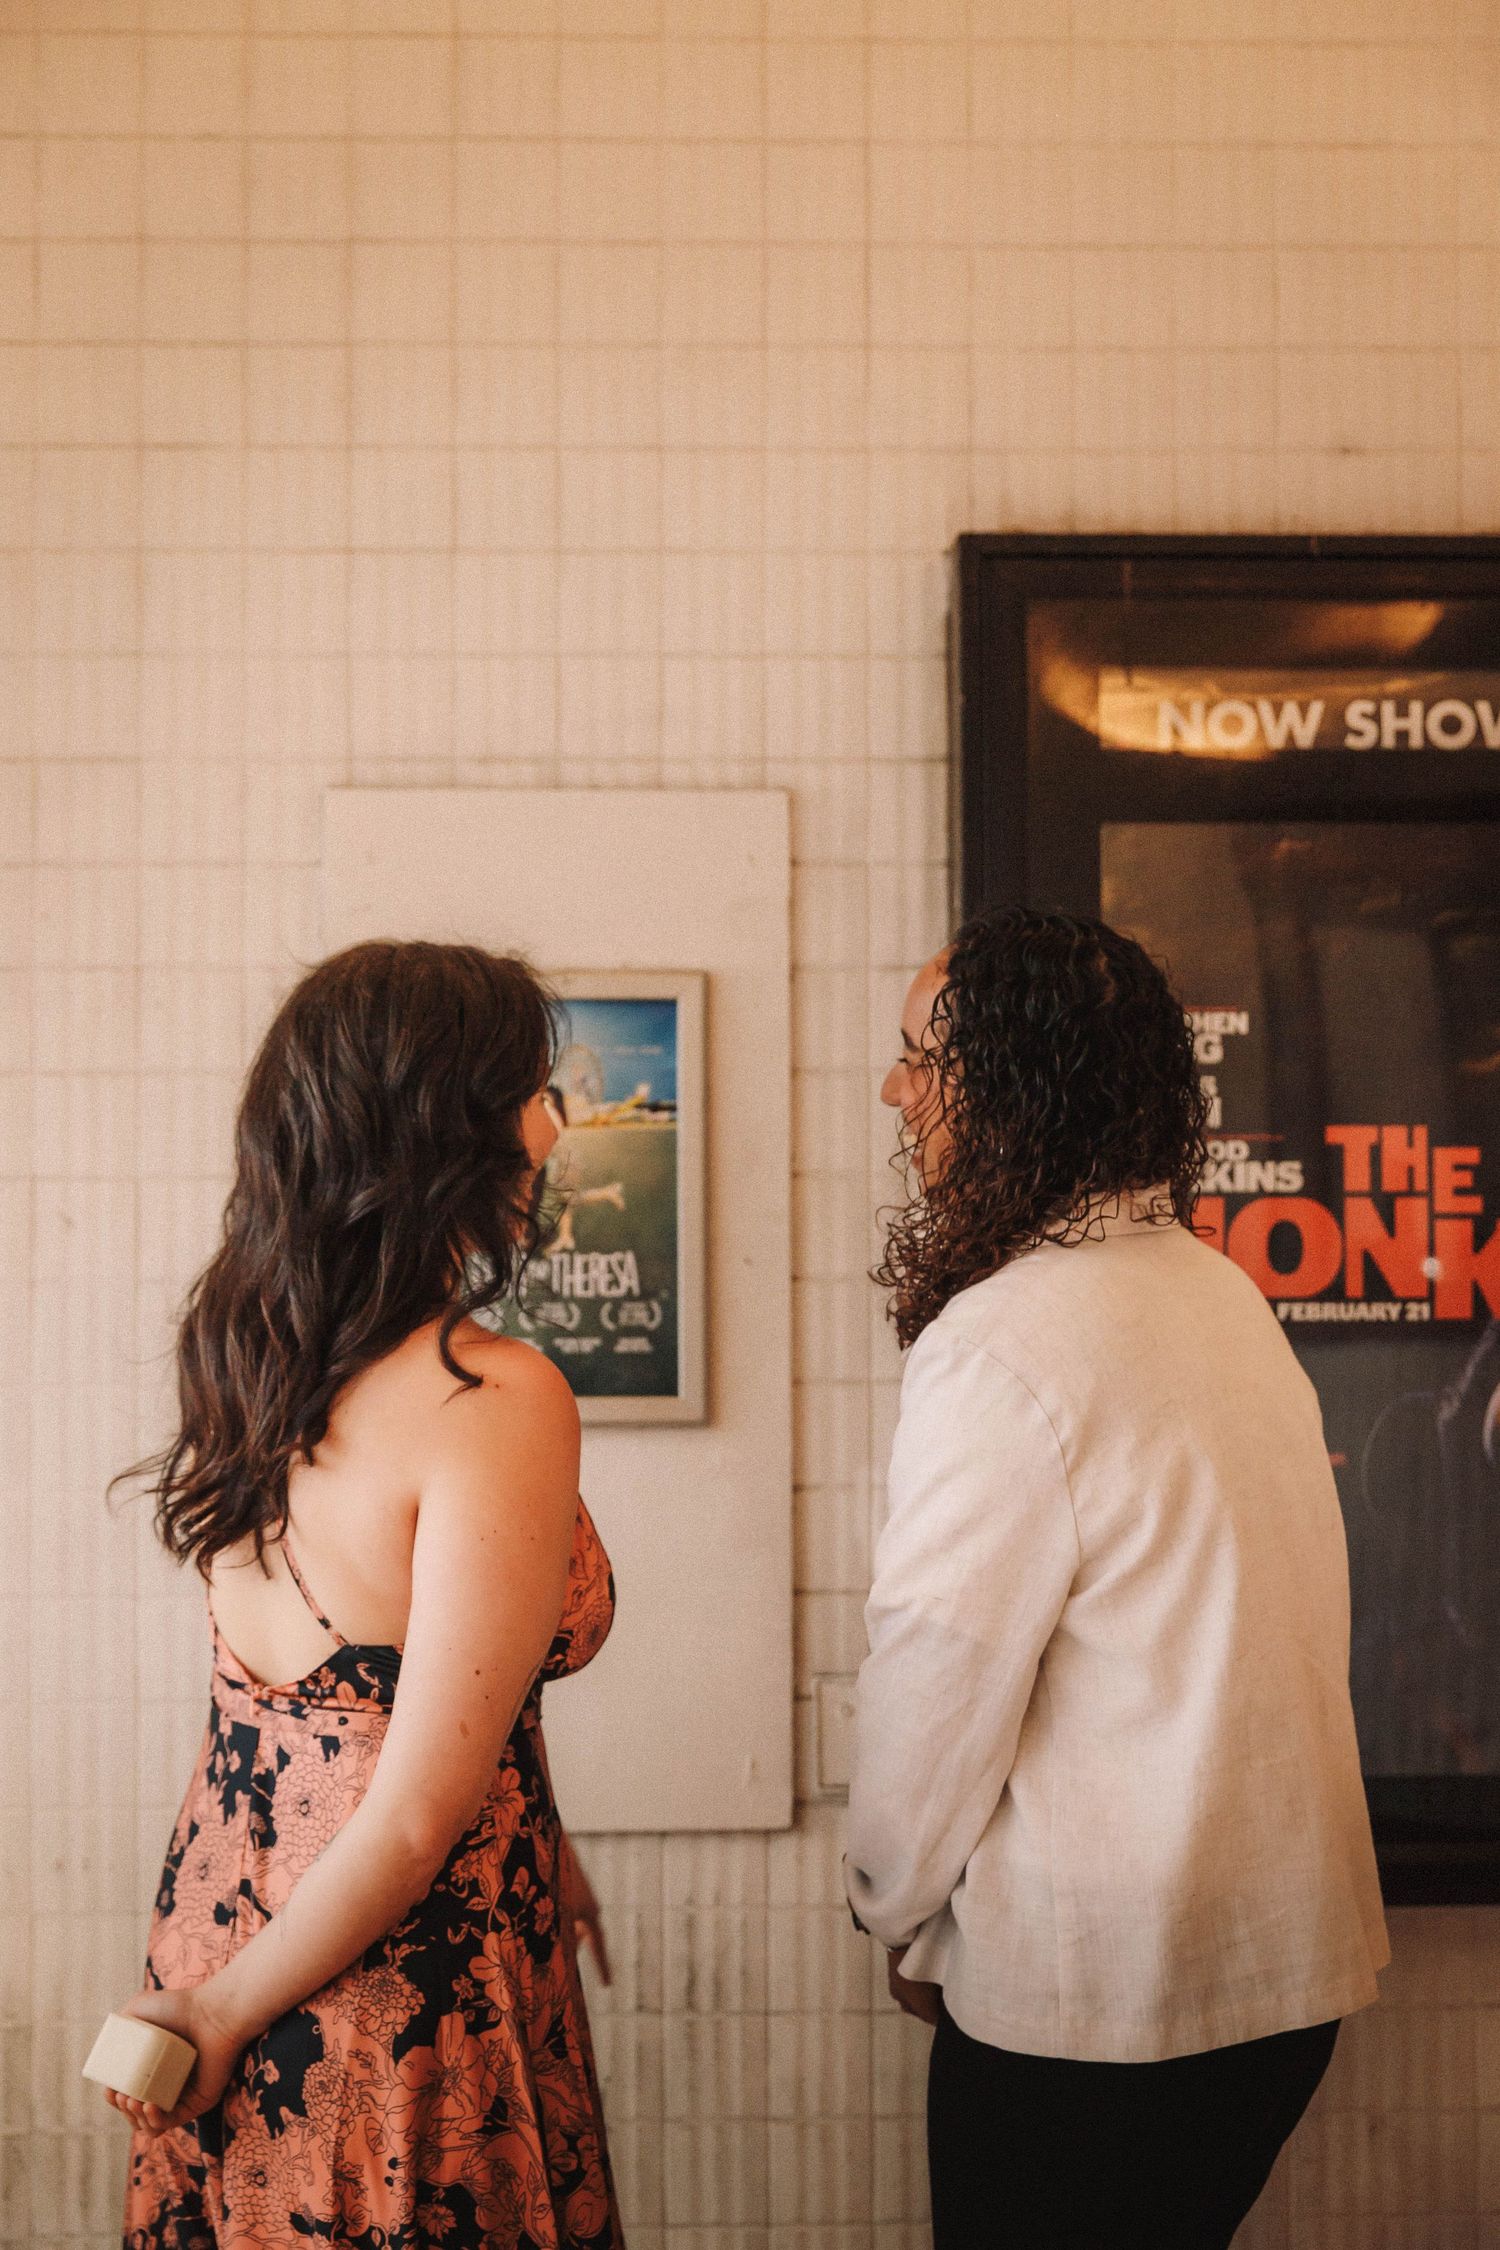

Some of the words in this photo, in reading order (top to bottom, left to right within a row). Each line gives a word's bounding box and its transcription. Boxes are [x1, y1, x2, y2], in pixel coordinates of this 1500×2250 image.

[1157, 698, 1325, 750] NOW
[1325, 1124, 1484, 1214] THE
[551, 1250, 640, 1298] THERESA
[1276, 1302, 1401, 1322] FEBRUARY
[1405, 1302, 1431, 1322] 21
